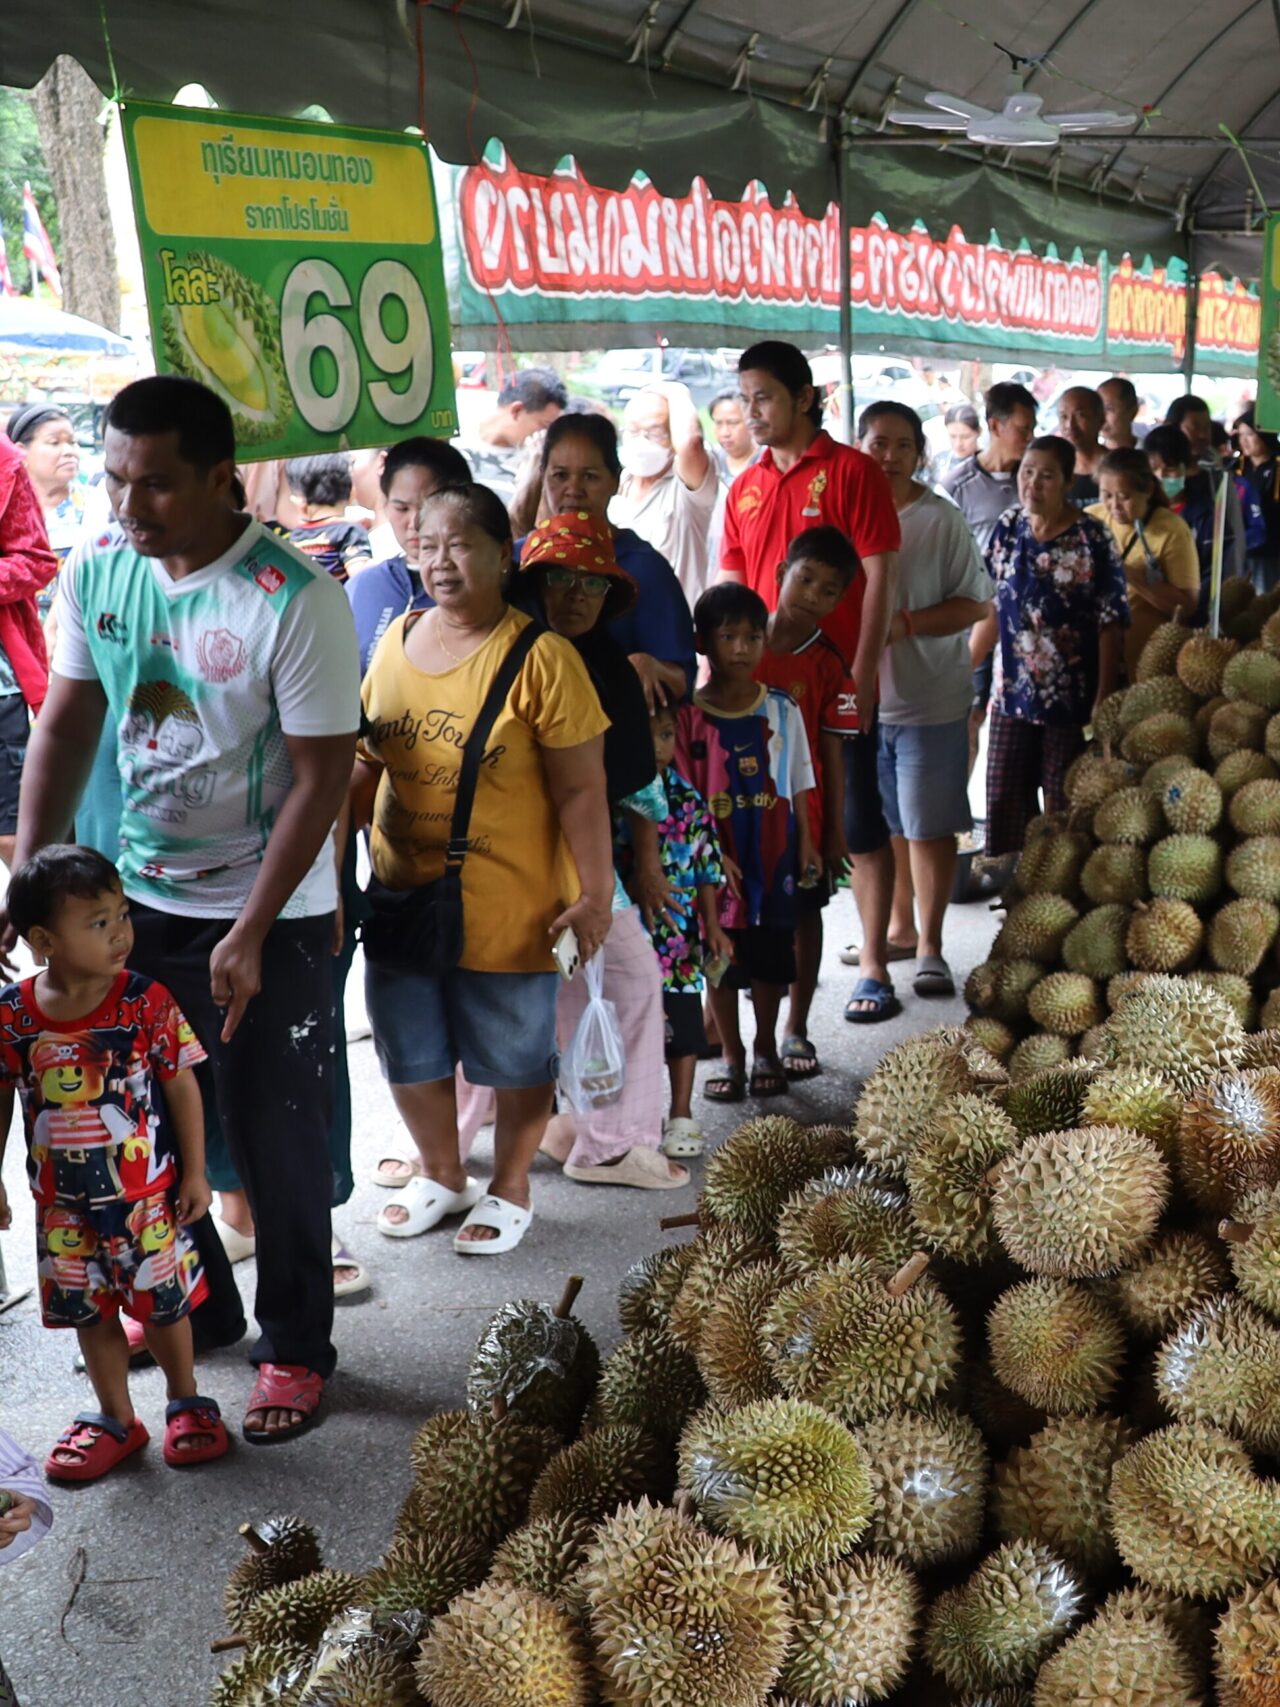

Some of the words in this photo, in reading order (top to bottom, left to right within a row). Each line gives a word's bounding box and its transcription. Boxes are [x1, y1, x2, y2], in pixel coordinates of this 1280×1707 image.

[201, 133, 373, 184] ทุเรียนหมอนทอง
[246, 196, 349, 232] ราคาโปรโมชั่น
[281, 256, 434, 433] 69
